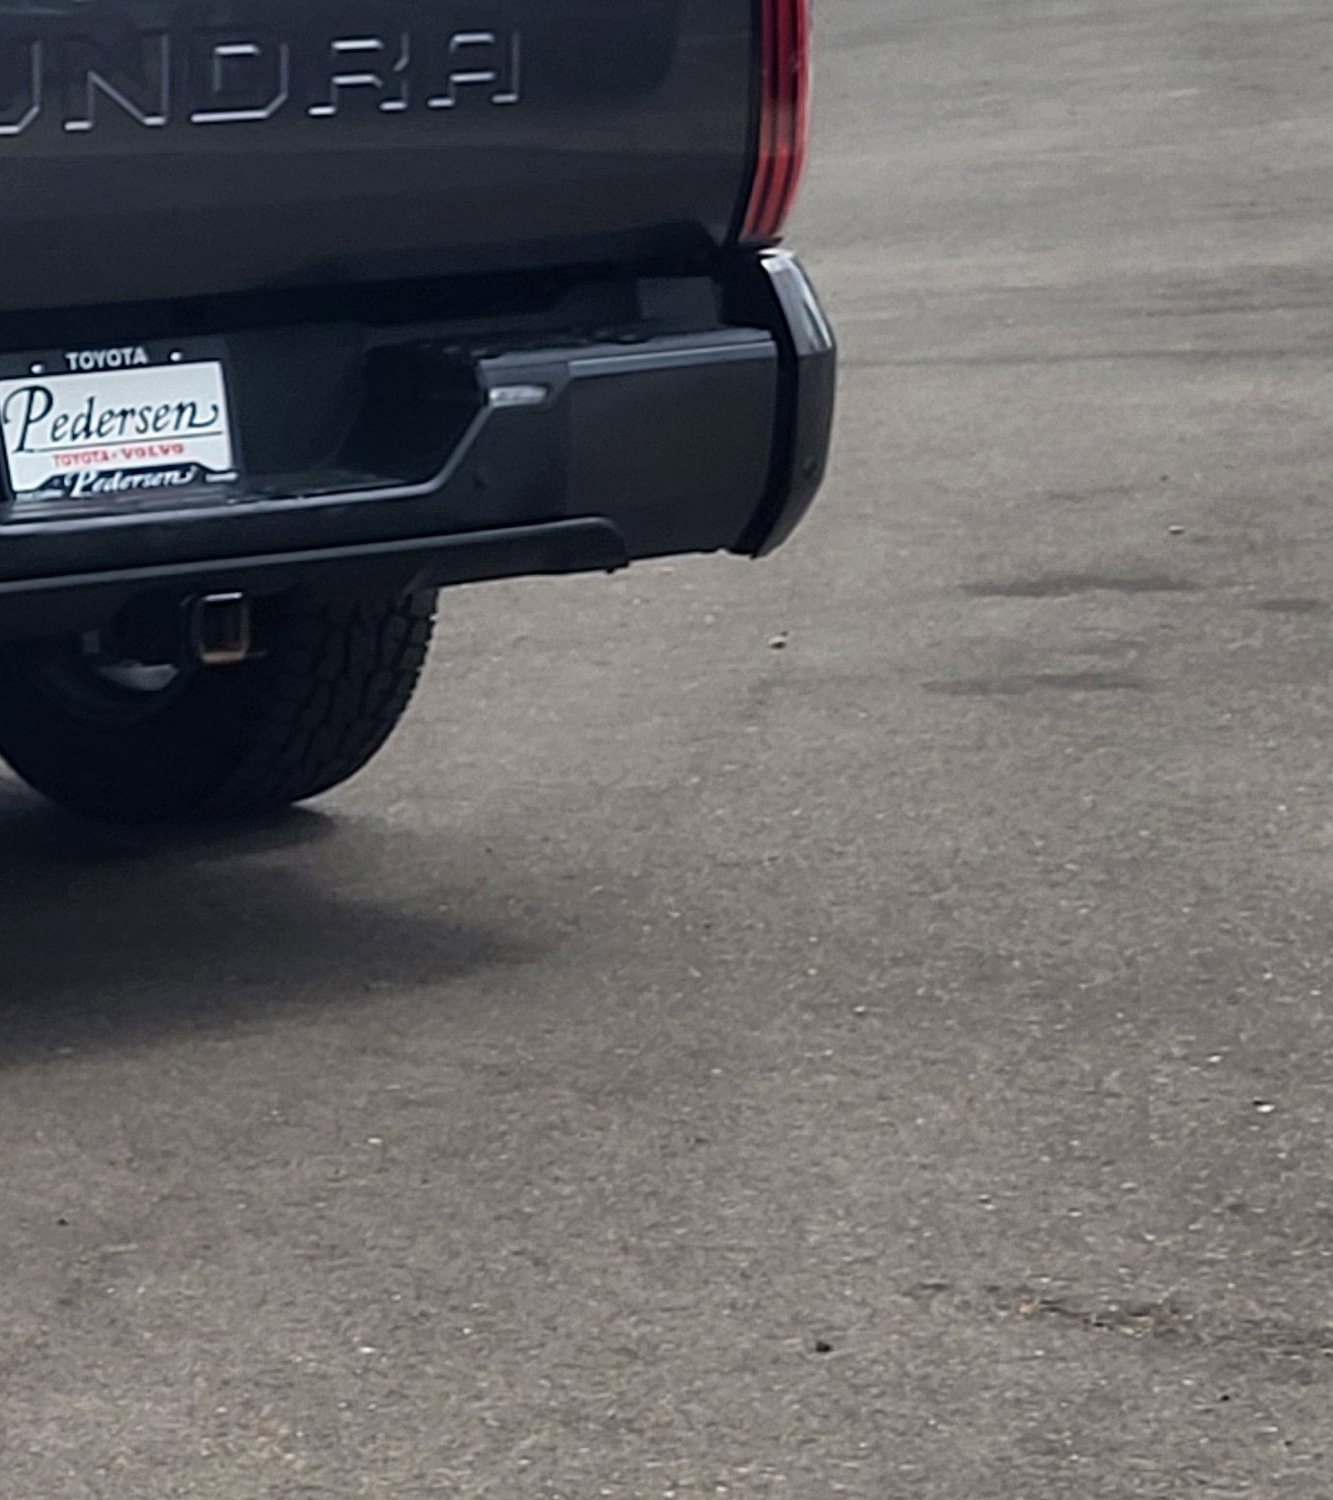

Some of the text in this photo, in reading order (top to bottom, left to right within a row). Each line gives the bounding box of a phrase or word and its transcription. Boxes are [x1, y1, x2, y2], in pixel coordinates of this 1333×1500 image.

[65, 346, 148, 371] TOYOTA
[2, 385, 220, 454] Pedersen
[52, 443, 185, 468] TOYOTA VOLVO
[63, 464, 198, 498] Pedersen
